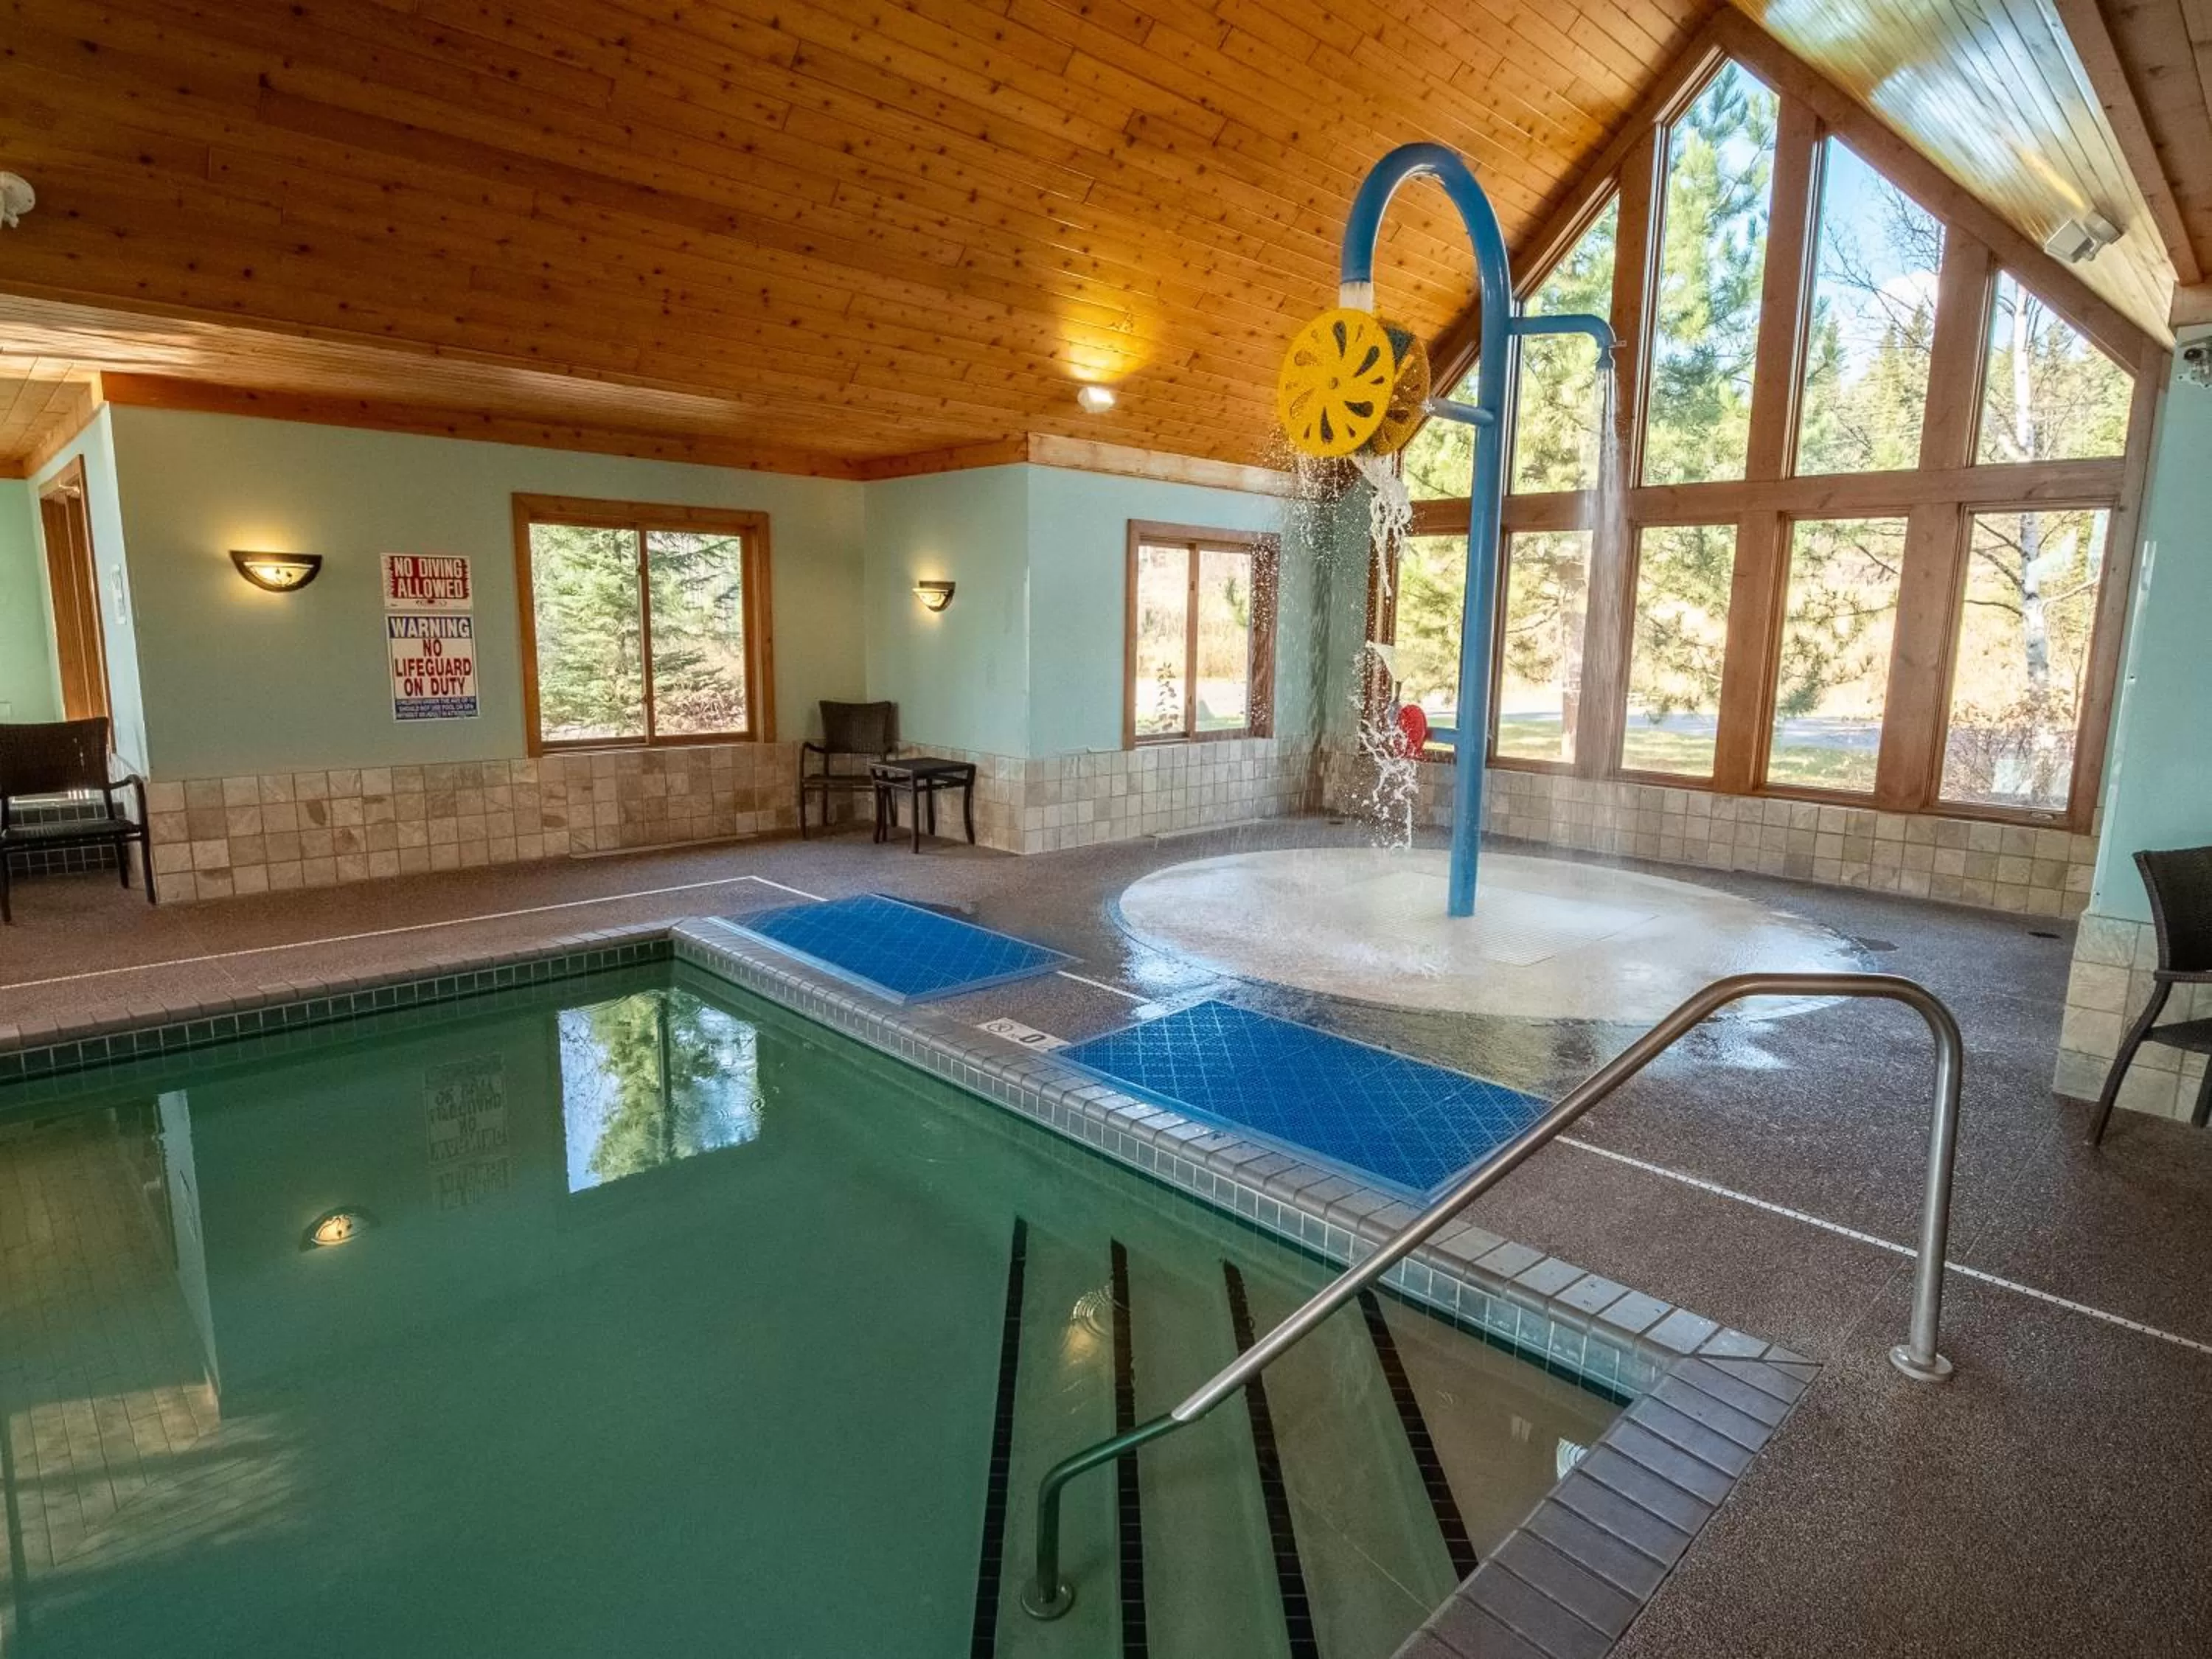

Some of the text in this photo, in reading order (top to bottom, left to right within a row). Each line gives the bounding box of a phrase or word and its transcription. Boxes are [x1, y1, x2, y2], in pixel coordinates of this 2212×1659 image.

[394, 557, 463, 578] NO DIVING
[397, 578, 464, 598] ALLOWED
[390, 618, 470, 637] WARNING
[422, 639, 442, 657] NO
[394, 658, 472, 677] LIFEGUARD
[404, 677, 466, 696] ON DUTY
